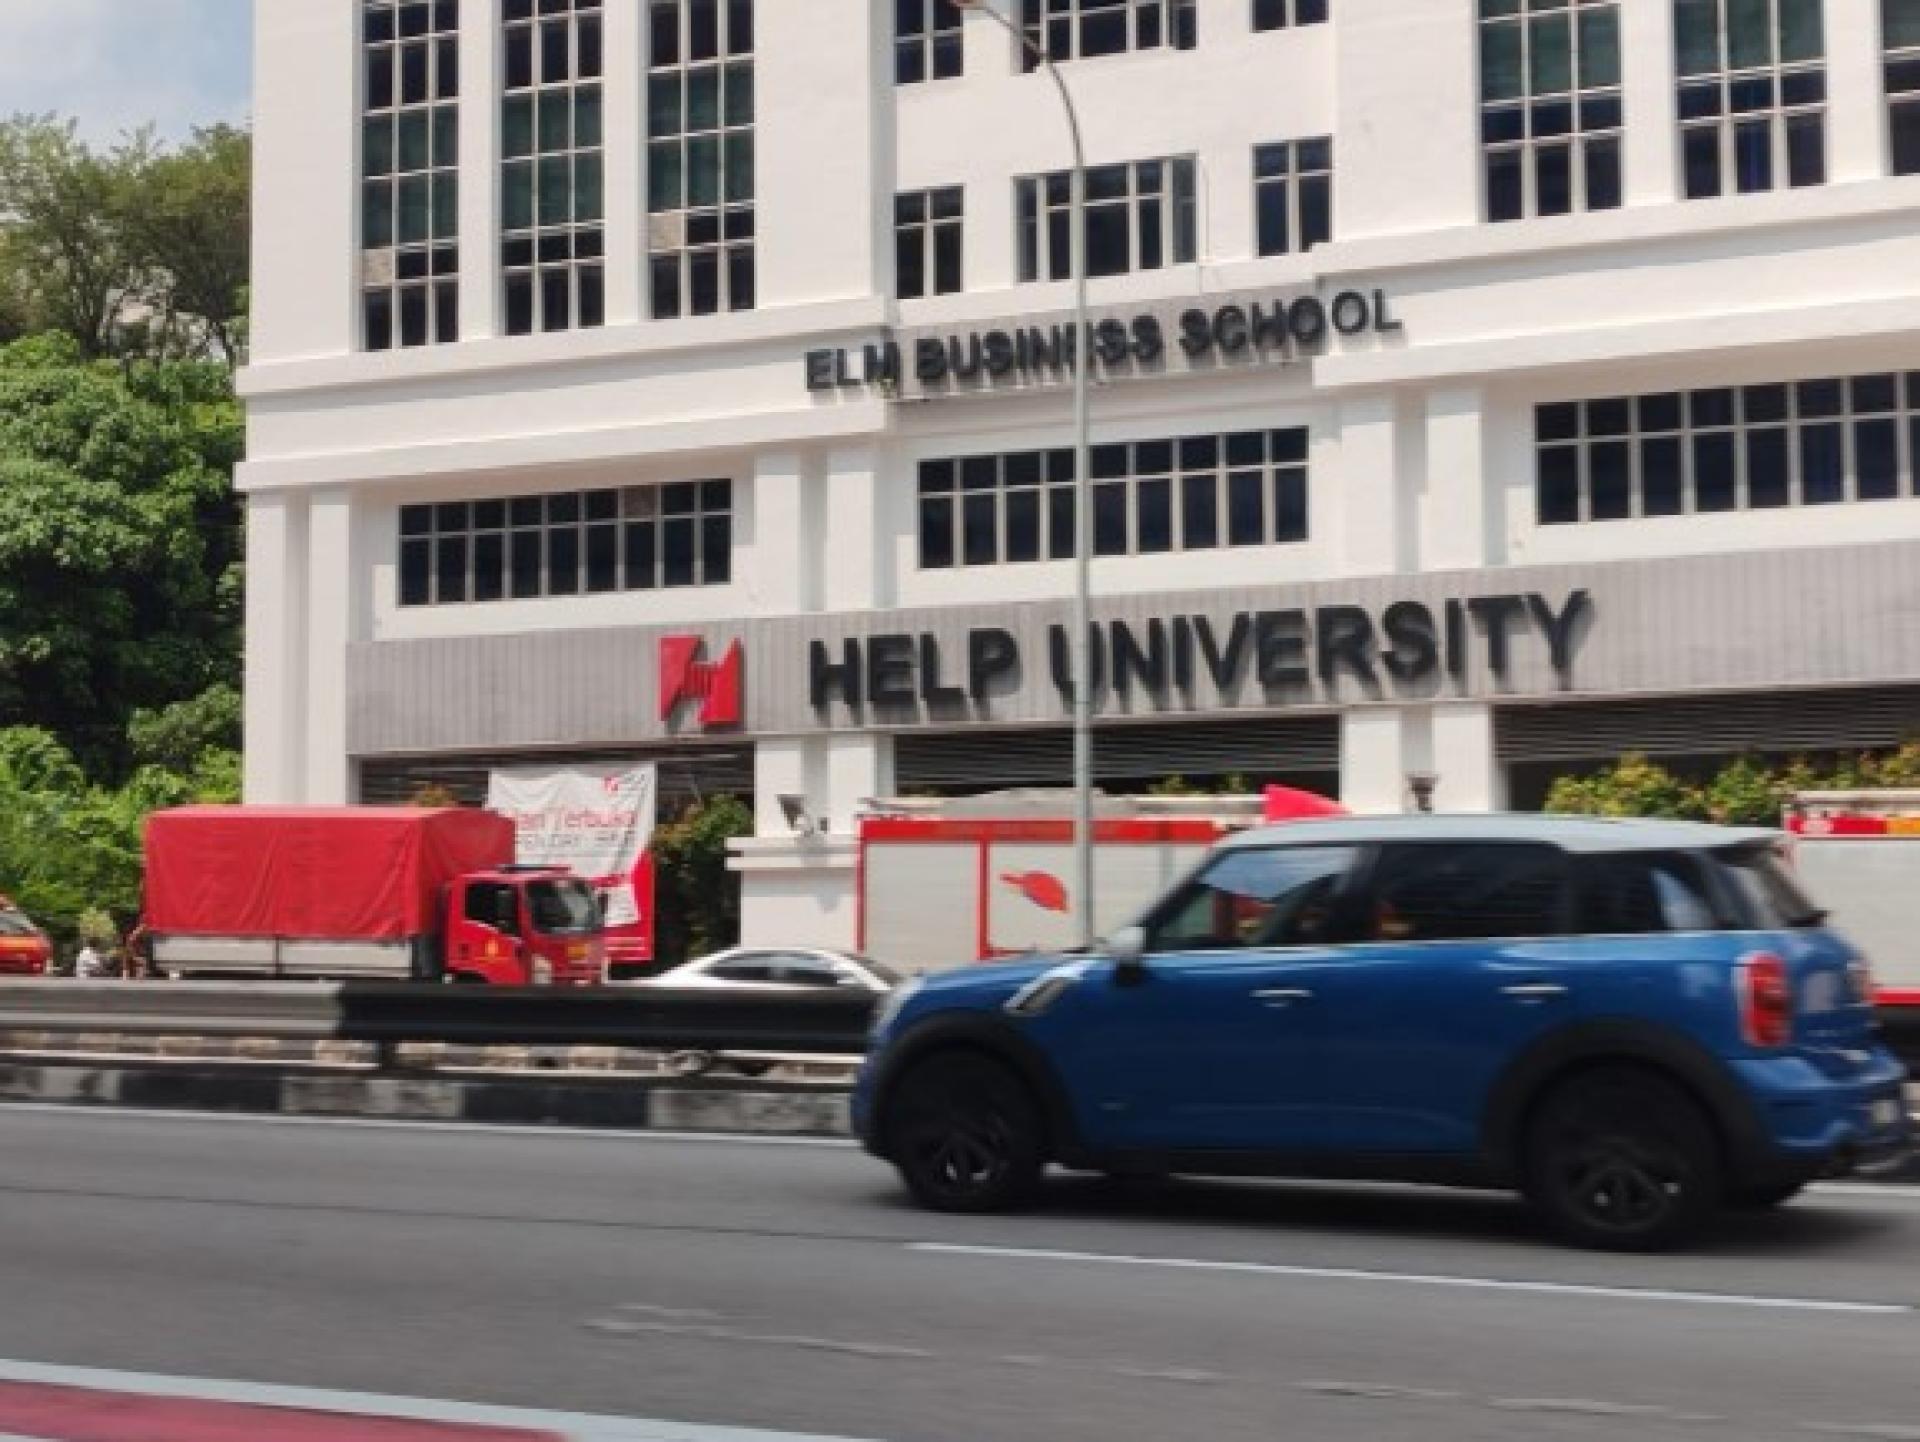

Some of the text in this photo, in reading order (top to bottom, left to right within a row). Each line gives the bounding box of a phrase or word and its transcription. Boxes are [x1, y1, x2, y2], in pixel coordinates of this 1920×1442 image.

[806, 340, 898, 390] ELM
[1178, 288, 1403, 356] SCHOOL
[809, 627, 1019, 714] HELP
[1048, 589, 1592, 703] UNIVERSITY
